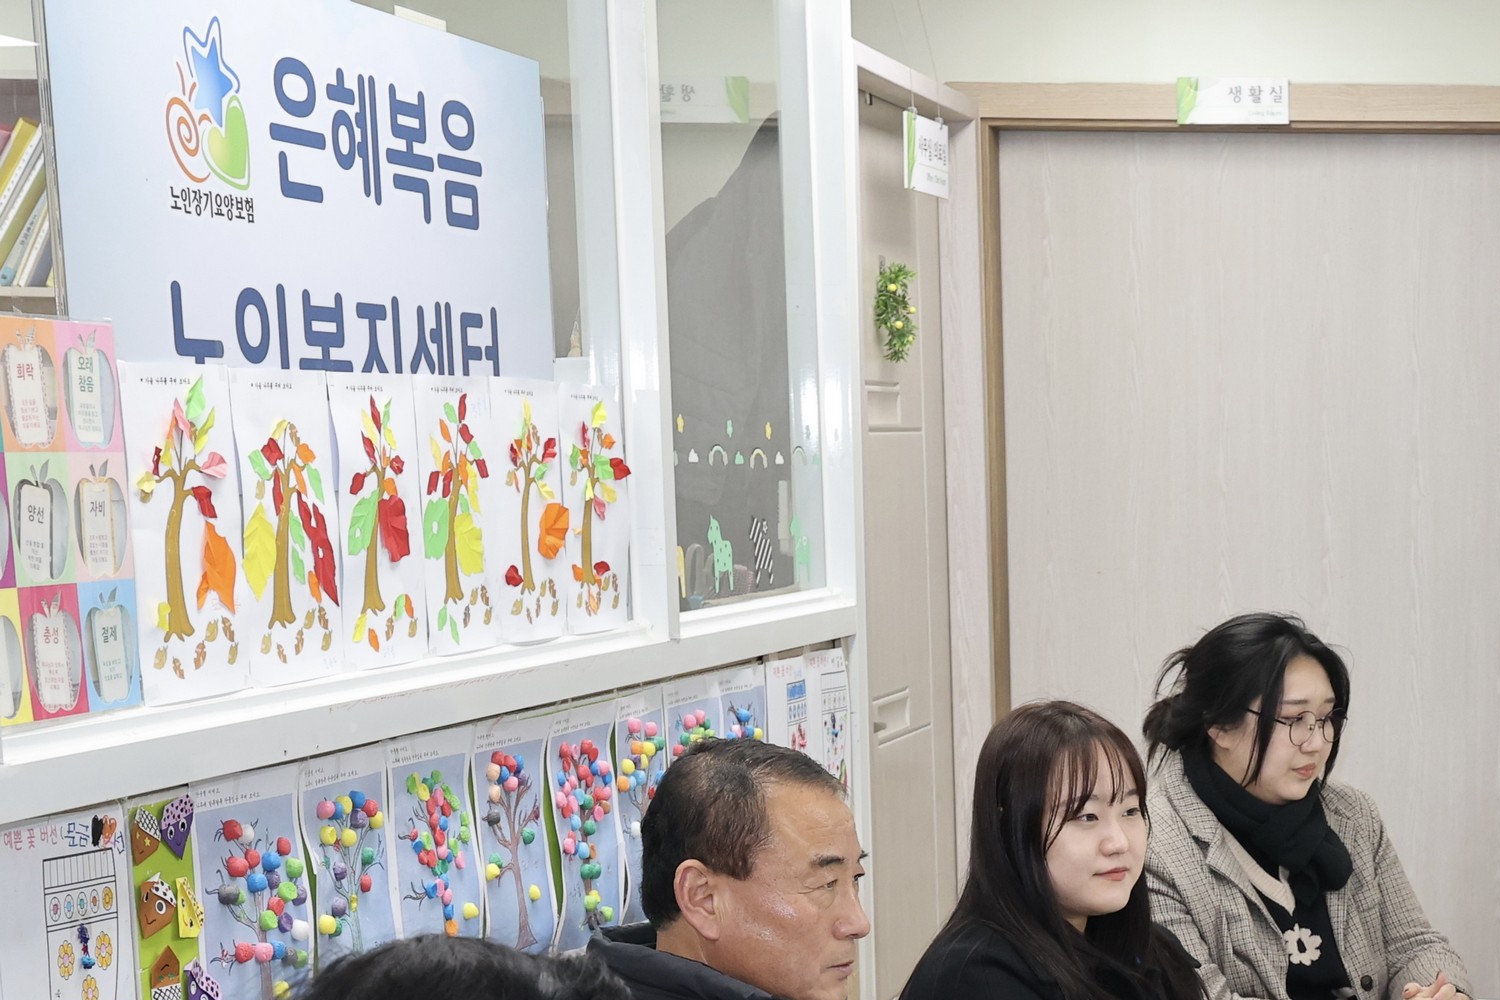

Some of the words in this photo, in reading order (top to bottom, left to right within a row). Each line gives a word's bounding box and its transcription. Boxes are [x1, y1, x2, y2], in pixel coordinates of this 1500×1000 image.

[270, 57, 483, 230] 은혜복음
[170, 186, 255, 223] 노인장기요양보험
[16, 363, 35, 381] 희락
[77, 355, 94, 374] 오래
[77, 375, 95, 393] 참음
[27, 503, 45, 525] 양선
[89, 500, 106, 517] 자비
[43, 625, 60, 645] 충성
[3, 830, 23, 851] 예쁜
[27, 828, 36, 849] 꽃
